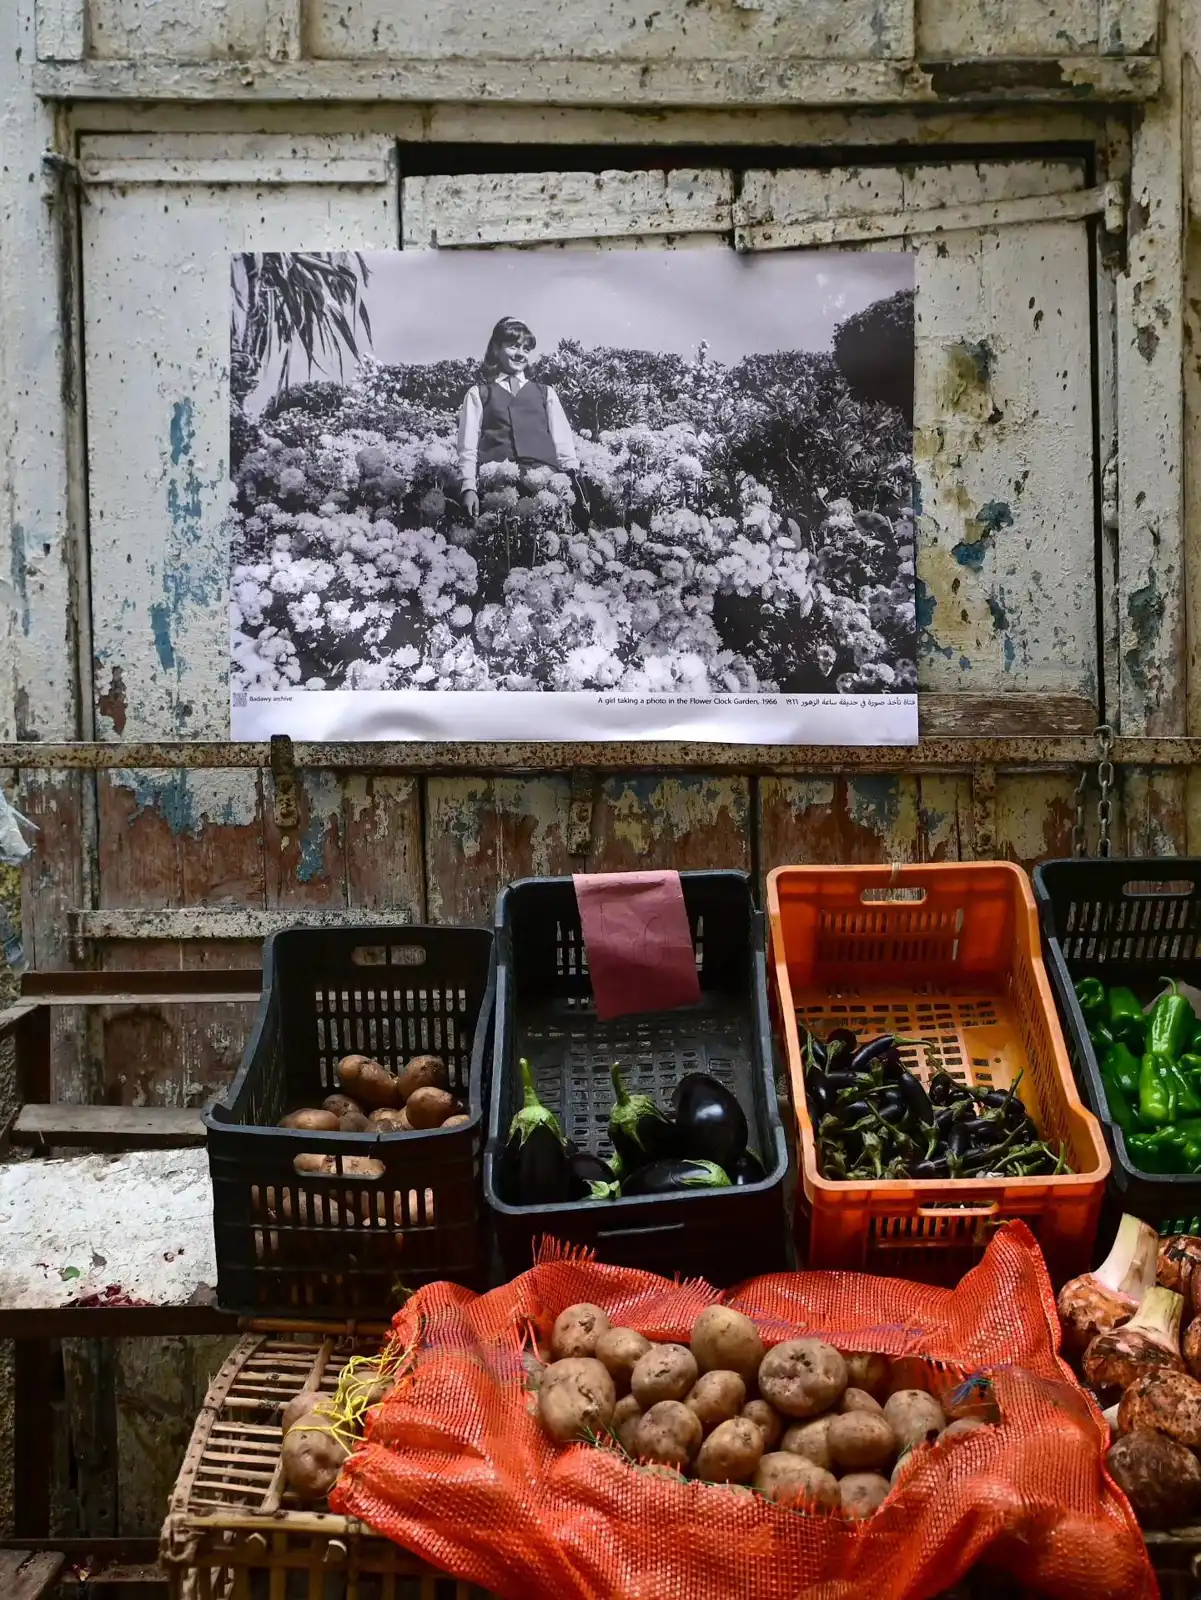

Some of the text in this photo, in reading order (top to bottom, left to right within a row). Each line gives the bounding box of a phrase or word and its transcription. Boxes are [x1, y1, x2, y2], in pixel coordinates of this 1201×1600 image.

[604, 697, 616, 706] girl
[618, 697, 638, 706] taking
[646, 697, 667, 706] photo
[733, 697, 760, 706] Garden,
[801, 698, 820, 707] الزهور
[821, 698, 838, 706] ساعة
[860, 698, 867, 708] في
[868, 698, 885, 707] صورة
[903, 698, 916, 706] فتاة
